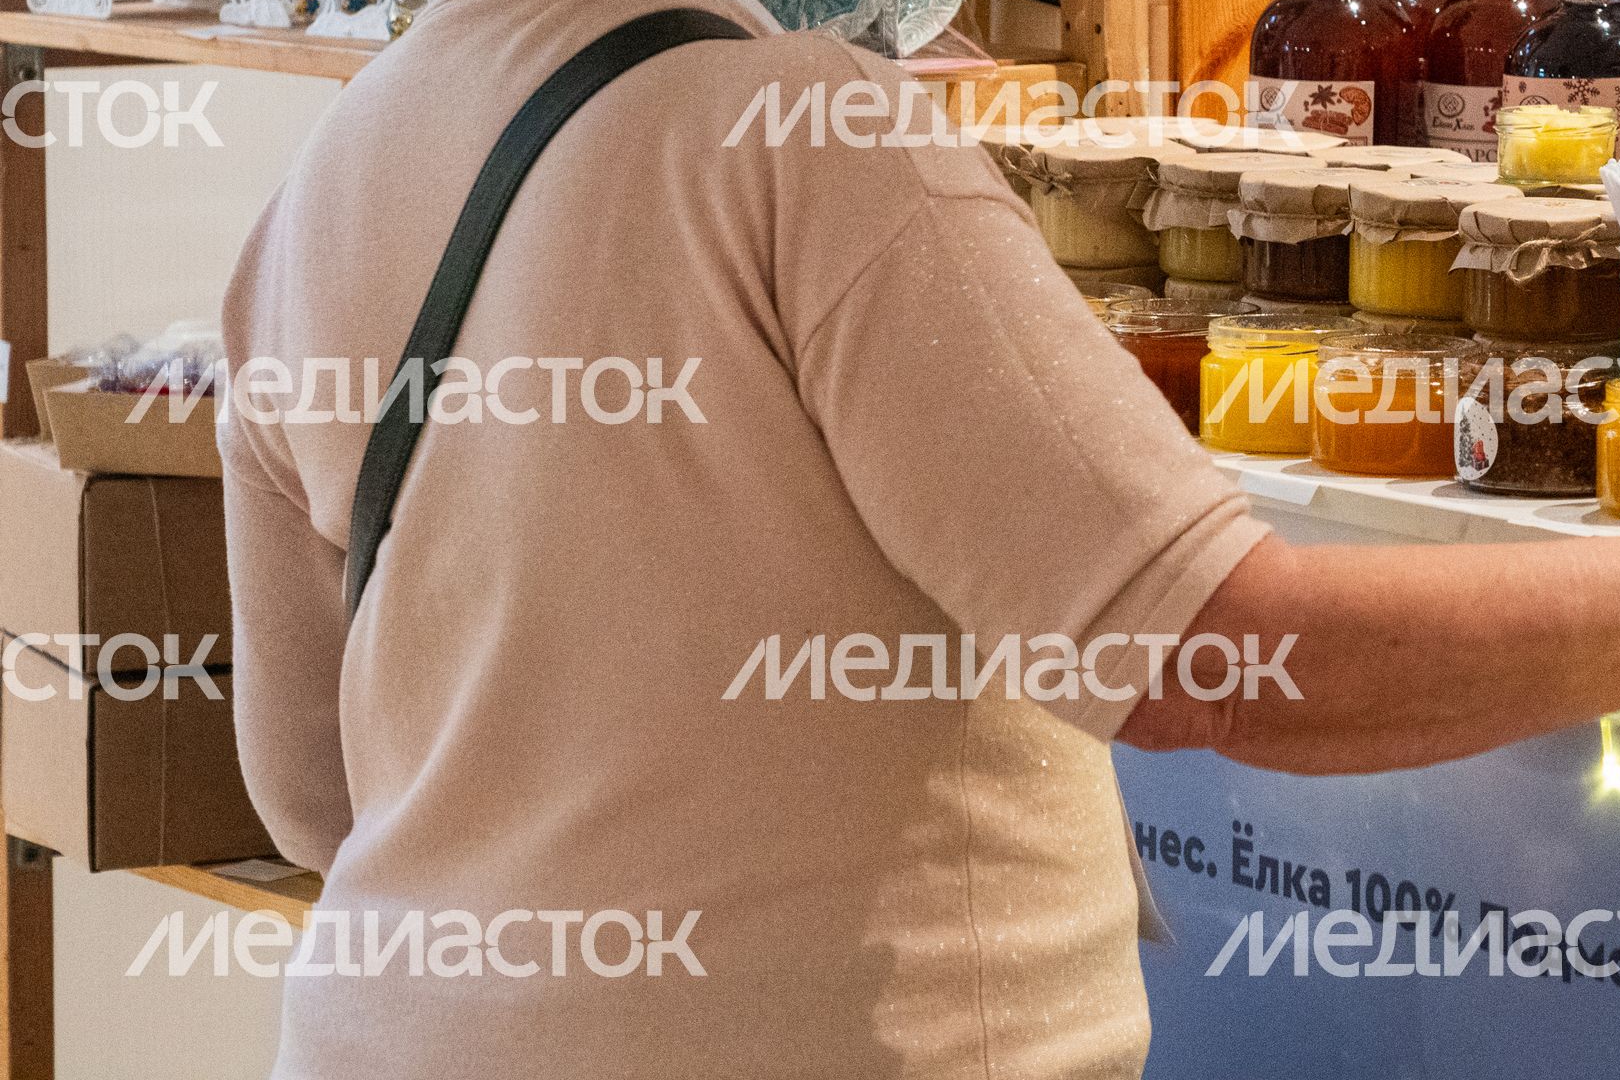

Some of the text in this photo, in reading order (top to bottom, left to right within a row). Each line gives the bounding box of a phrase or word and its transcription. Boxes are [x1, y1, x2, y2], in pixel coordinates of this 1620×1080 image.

[1135, 821, 1218, 879] нес.
[1231, 819, 1332, 908] Ёлка
[1345, 868, 1463, 944] 100%
